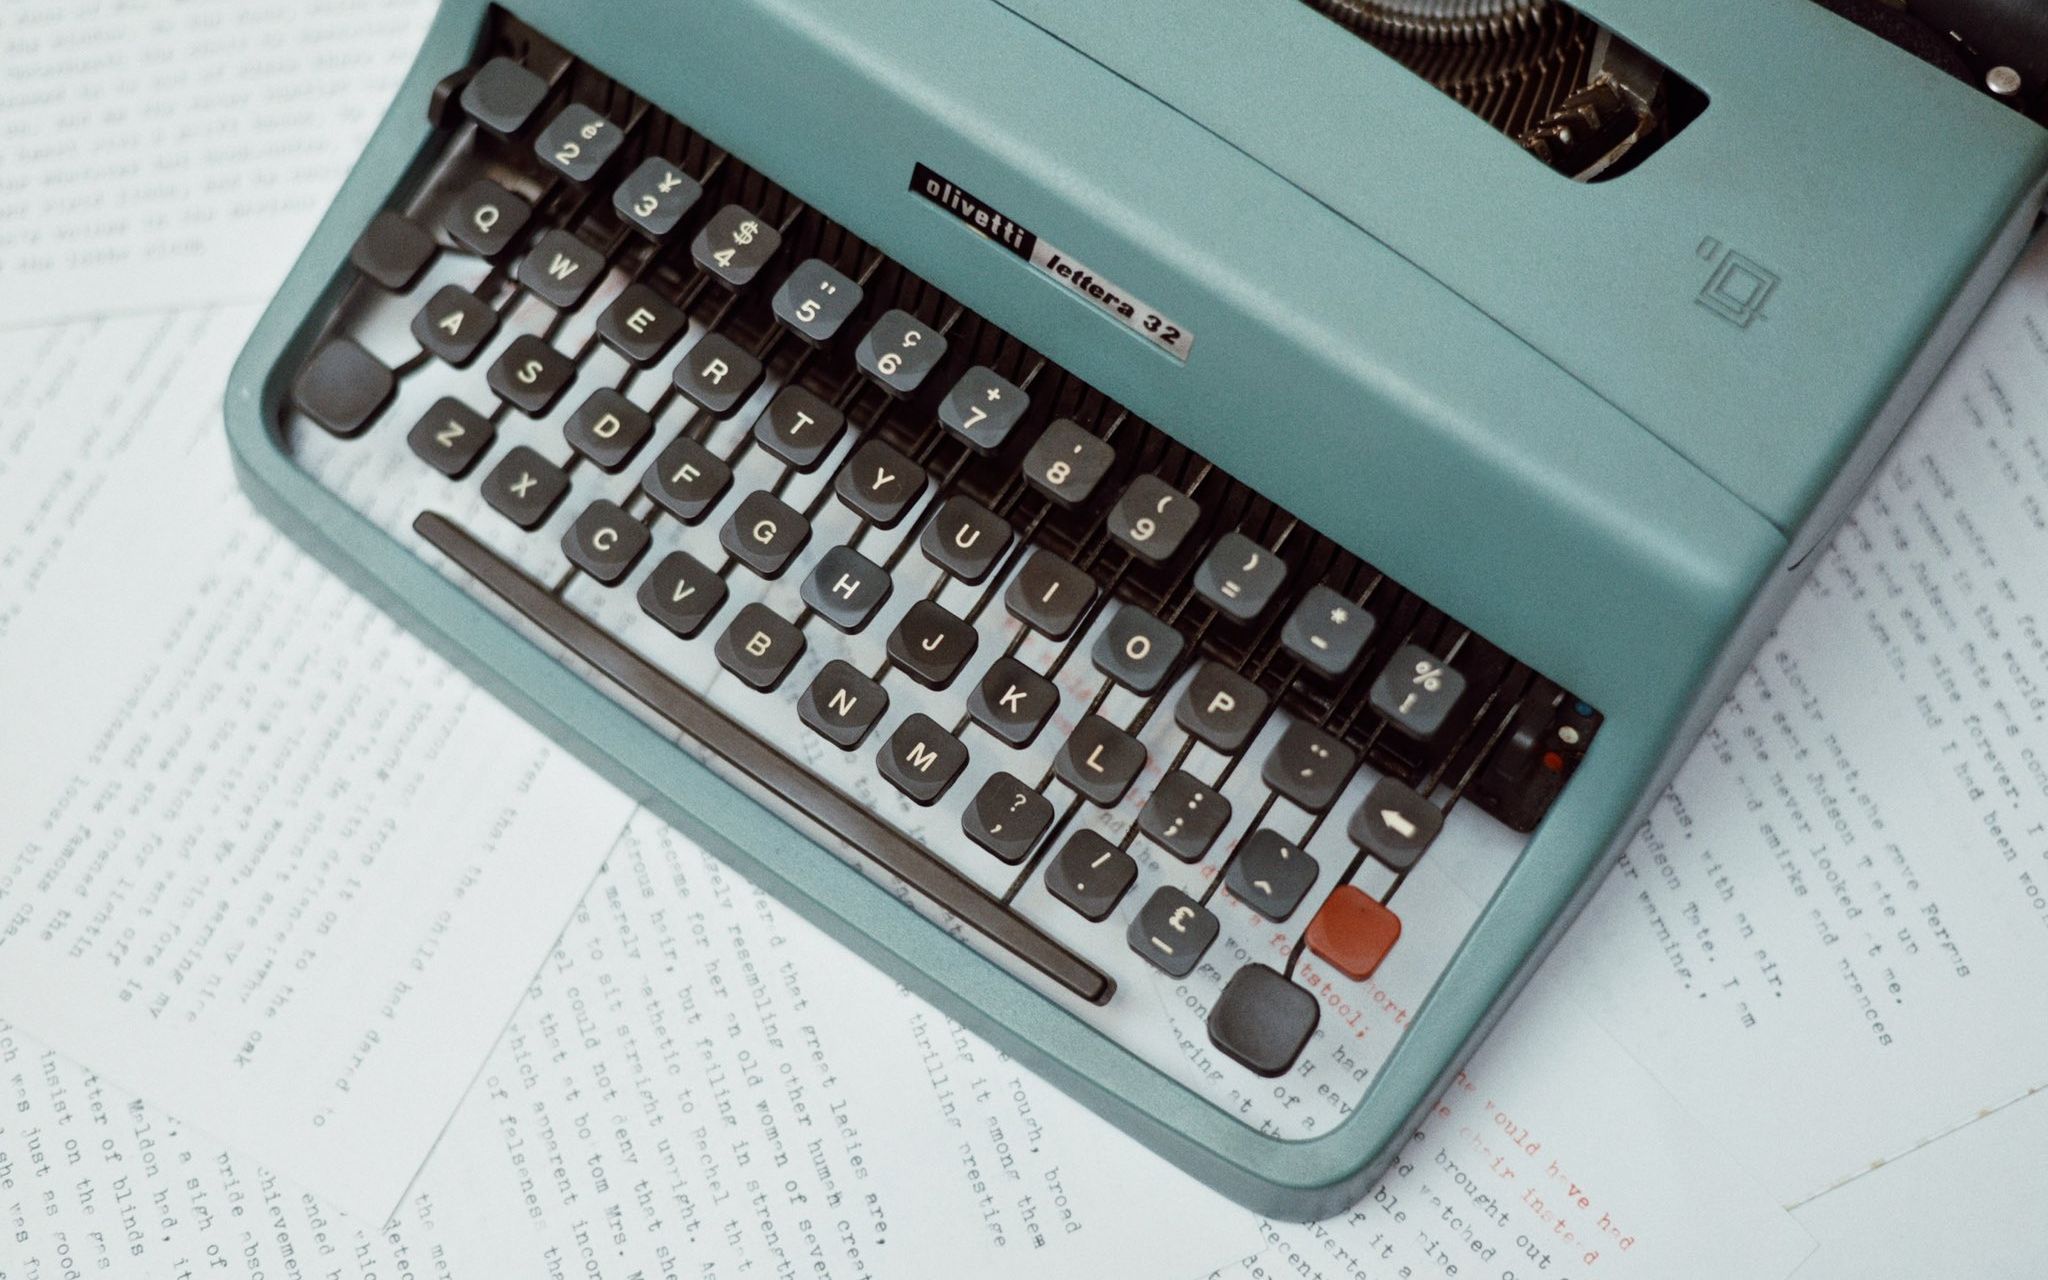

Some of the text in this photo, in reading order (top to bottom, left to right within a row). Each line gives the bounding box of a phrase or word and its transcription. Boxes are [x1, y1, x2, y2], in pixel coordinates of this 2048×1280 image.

[555, 143, 580, 166] 2
[474, 205, 499, 233] Q
[634, 195, 658, 217] 3
[733, 220, 758, 245] $
[549, 253, 578, 280] W
[713, 249, 736, 268] 4
[926, 178, 1182, 346] olivetti lettera 32
[440, 312, 464, 335] A
[626, 308, 656, 334] E
[796, 299, 821, 322] 5
[518, 360, 543, 383] S
[702, 358, 728, 385] R
[878, 353, 902, 375] 6
[593, 414, 620, 438] D
[790, 411, 814, 434] T
[963, 406, 987, 429] 7
[436, 421, 465, 447] Z
[510, 472, 537, 498] X
[672, 464, 701, 483] F
[872, 467, 895, 490] Y
[1046, 461, 1070, 484] 8
[593, 528, 618, 551] C
[753, 520, 777, 544] G
[955, 524, 980, 548] U
[1130, 518, 1155, 541] 9
[672, 579, 695, 602] V
[832, 573, 860, 600] H
[1042, 582, 1059, 602] I
[745, 631, 772, 656] B
[922, 634, 944, 651] J
[1126, 635, 1150, 660] O
[1413, 661, 1443, 692] %
[828, 688, 857, 716] N
[999, 684, 1027, 713] K
[1207, 691, 1235, 712] P
[906, 742, 938, 772] M
[1086, 744, 1104, 772] L
[338, 877, 362, 901] it
[454, 867, 483, 899] the
[316, 911, 338, 935] on
[1169, 906, 1195, 932] £
[294, 949, 317, 971] to
[687, 911, 711, 948] for
[705, 958, 729, 998] her
[587, 936, 605, 961] to
[598, 973, 624, 1012] sit
[264, 985, 295, 1019] the
[727, 923, 785, 1050] resembling
[779, 1062, 813, 1127] other
[678, 984, 703, 1025] but
[732, 1140, 751, 1168] in
[910, 1013, 963, 1129] thrilling
[486, 1075, 509, 1100] of
[971, 1077, 992, 1103] it
[1273, 1086, 1301, 1109] of
[566, 986, 602, 1050] could
[592, 1061, 618, 1103] not
[633, 1179, 664, 1233] that
[677, 1088, 695, 1114] to
[780, 961, 809, 1012] that
[829, 1098, 869, 1180] ladies
[864, 1192, 888, 1246] are,
[40, 1049, 95, 1215] insist on the
[736, 1049, 765, 1088] old
[784, 1180, 808, 1205] of
[22, 1127, 51, 1178] just
[42, 1189, 59, 1217] as
[101, 1138, 145, 1257] of blinds
[414, 1191, 435, 1230] the
[1044, 1165, 1083, 1235] broad
[301, 1192, 336, 1255] ended
[605, 1203, 627, 1257] Mrs.
[206, 1244, 228, 1268] of
[1369, 1233, 1394, 1260] it
[1515, 1234, 1552, 1270] out
